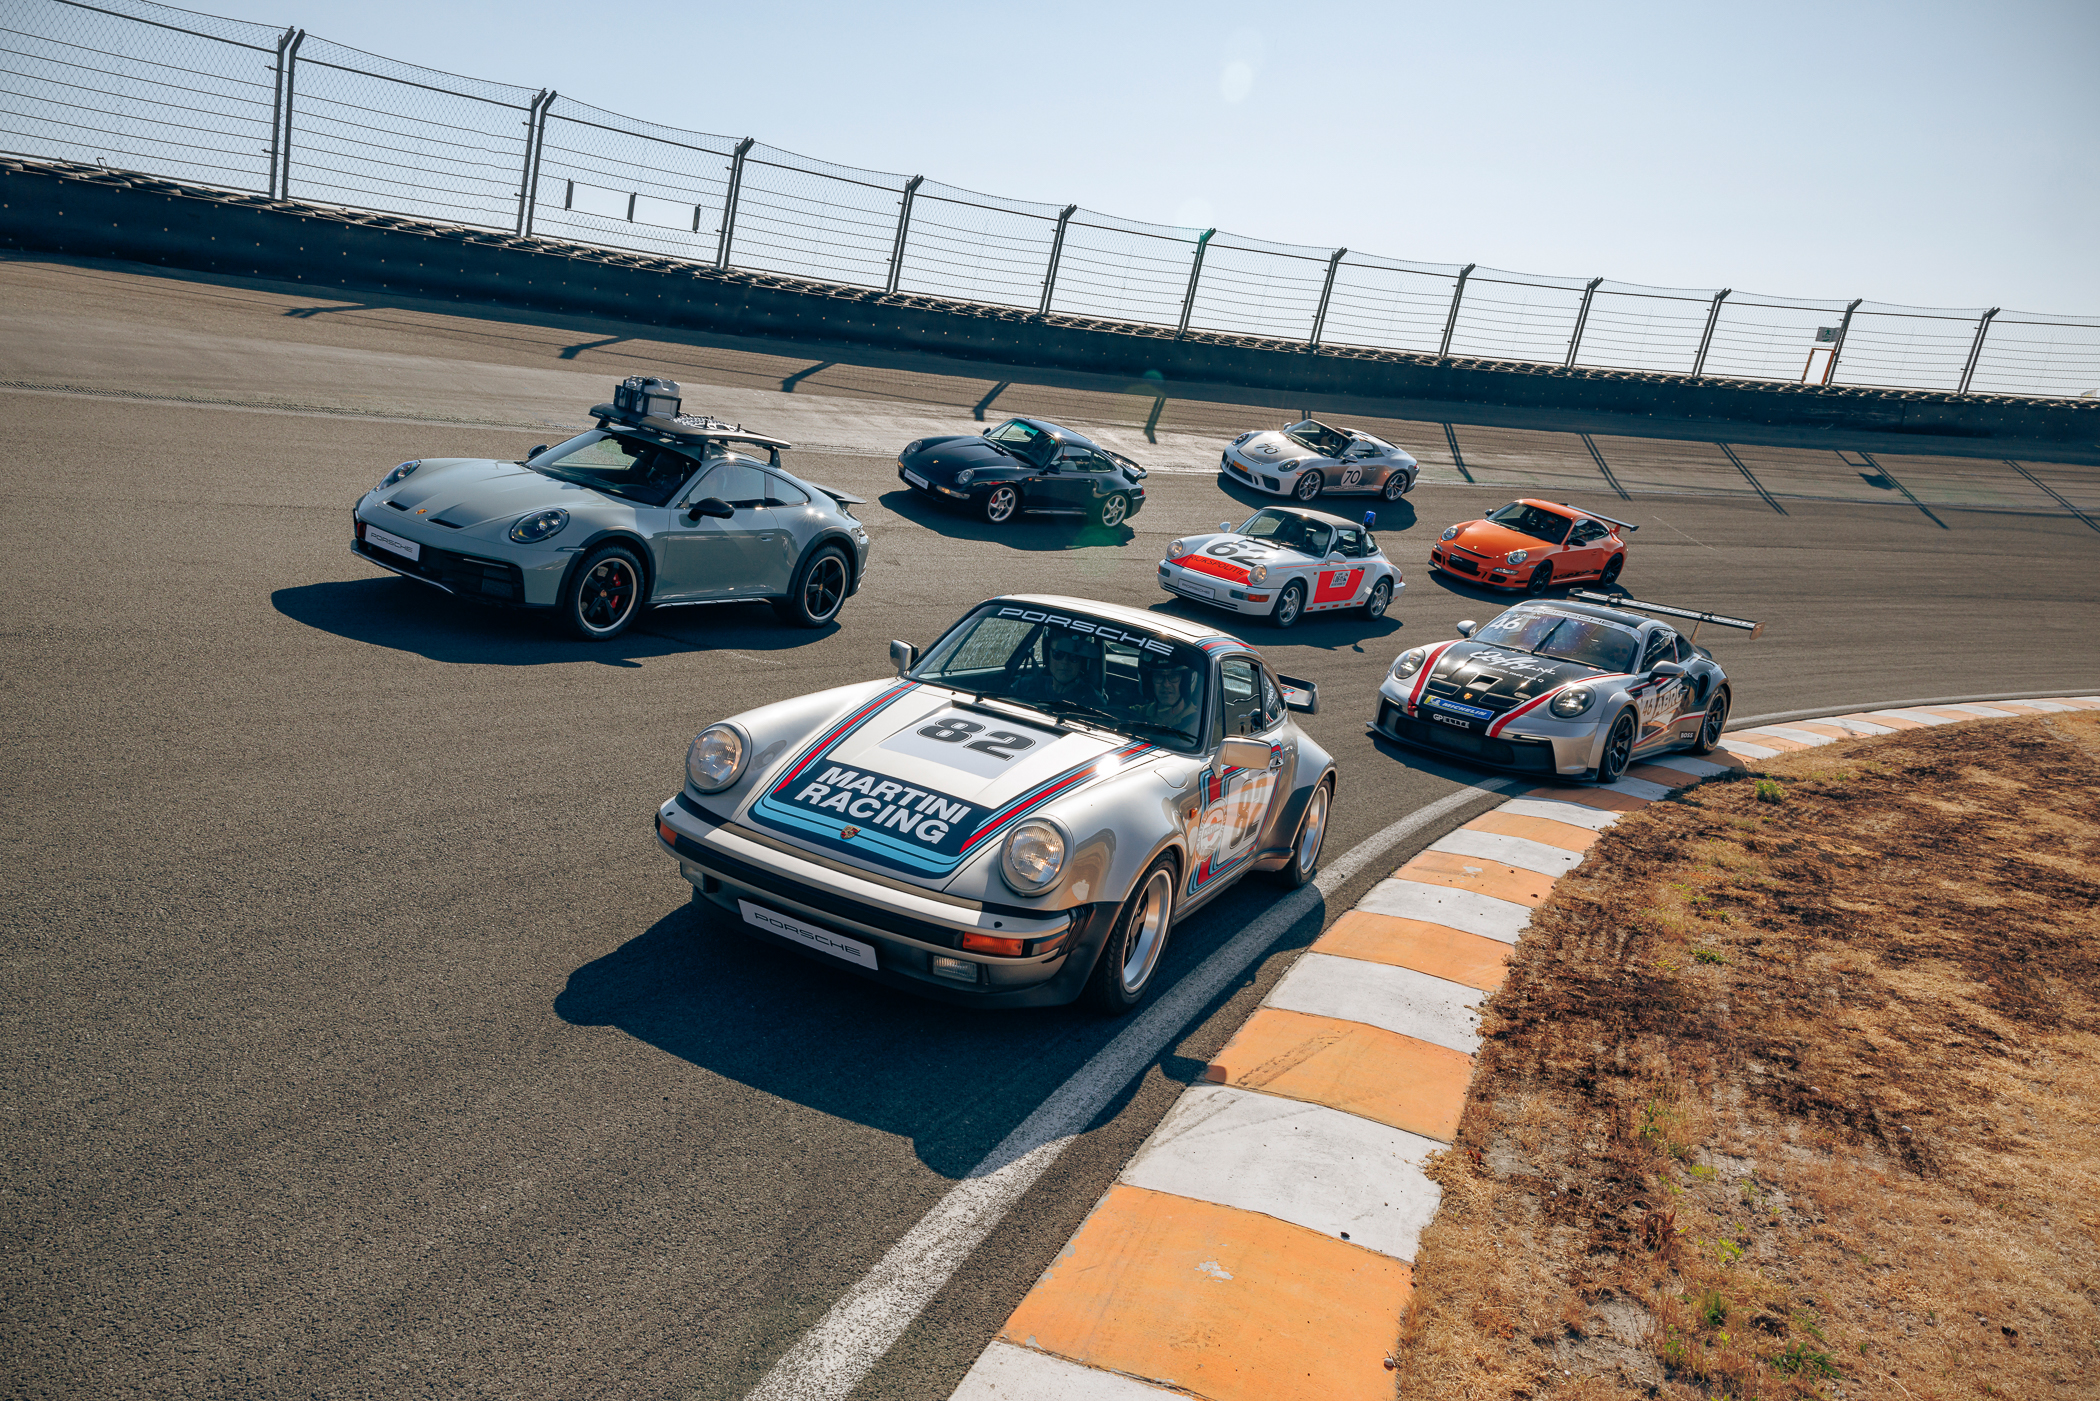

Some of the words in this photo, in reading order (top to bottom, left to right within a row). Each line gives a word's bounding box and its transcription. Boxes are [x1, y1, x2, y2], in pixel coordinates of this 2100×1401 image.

[1256, 443, 1279, 454] 70
[1343, 470, 1360, 484] 70
[371, 532, 413, 553] PORSCHE
[1206, 542, 1269, 567] 62
[998, 607, 1174, 656] PORSCHE
[1488, 617, 1520, 630] 46
[1442, 702, 1487, 716] MICHELIN
[1642, 699, 1653, 717] 46
[916, 718, 1036, 761] 82
[815, 766, 972, 825] MARTINI
[794, 782, 950, 845] RACING
[1229, 771, 1267, 849] 82
[754, 912, 861, 957] PORSCHE
